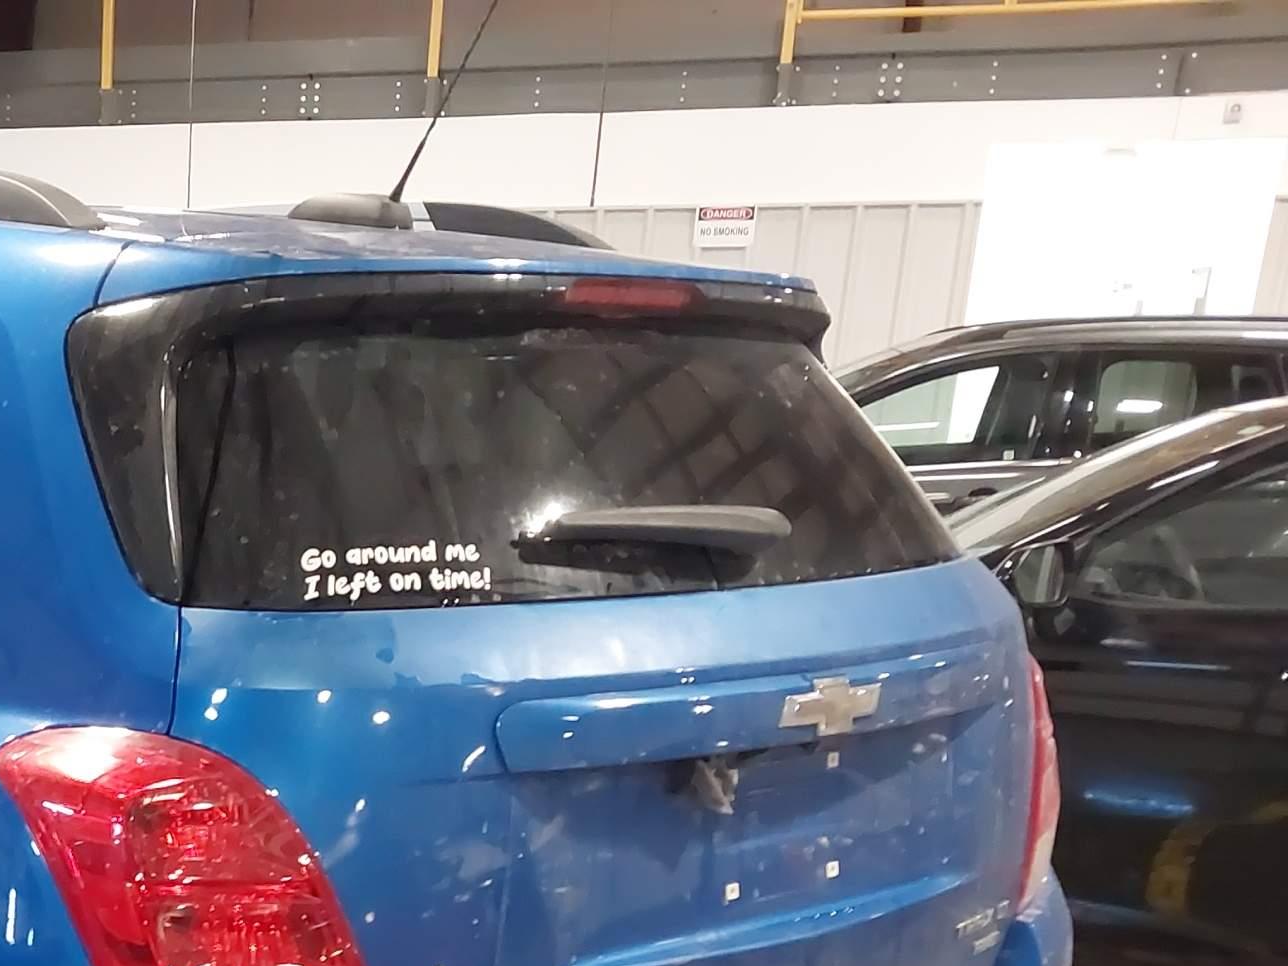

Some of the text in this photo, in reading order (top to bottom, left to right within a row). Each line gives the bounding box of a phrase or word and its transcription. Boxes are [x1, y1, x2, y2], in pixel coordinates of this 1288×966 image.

[700, 226, 749, 236] NO SMOKING
[300, 539, 480, 572] Go around me
[304, 566, 492, 601] I left on time!
